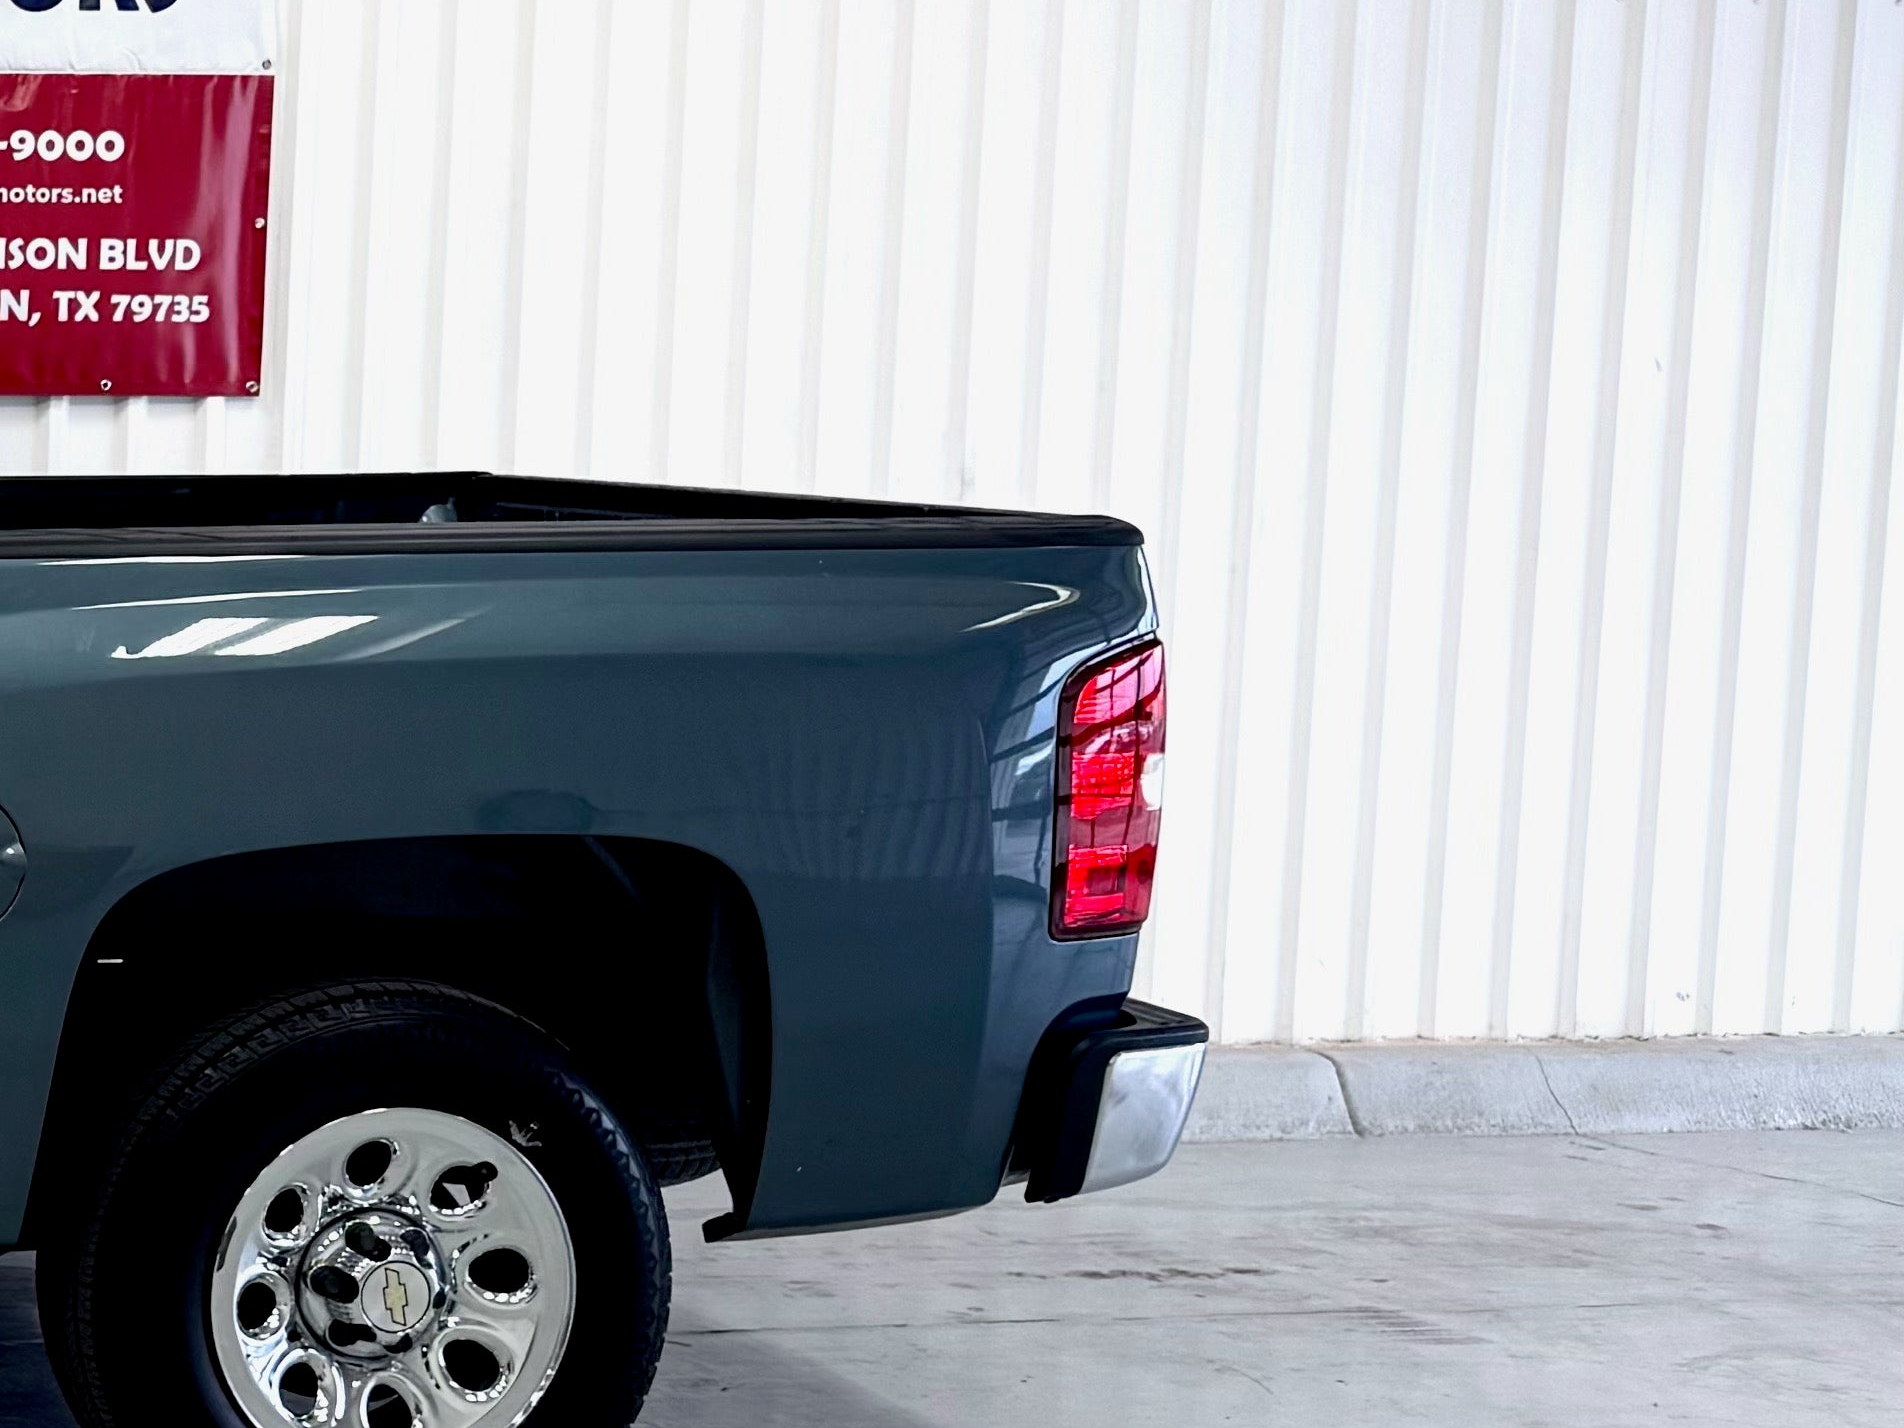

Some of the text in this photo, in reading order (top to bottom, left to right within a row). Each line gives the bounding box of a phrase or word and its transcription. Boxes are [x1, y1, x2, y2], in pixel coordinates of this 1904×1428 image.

[99, 238, 201, 271] BLVD
[52, 290, 101, 322] TX
[110, 294, 210, 323] 79735
